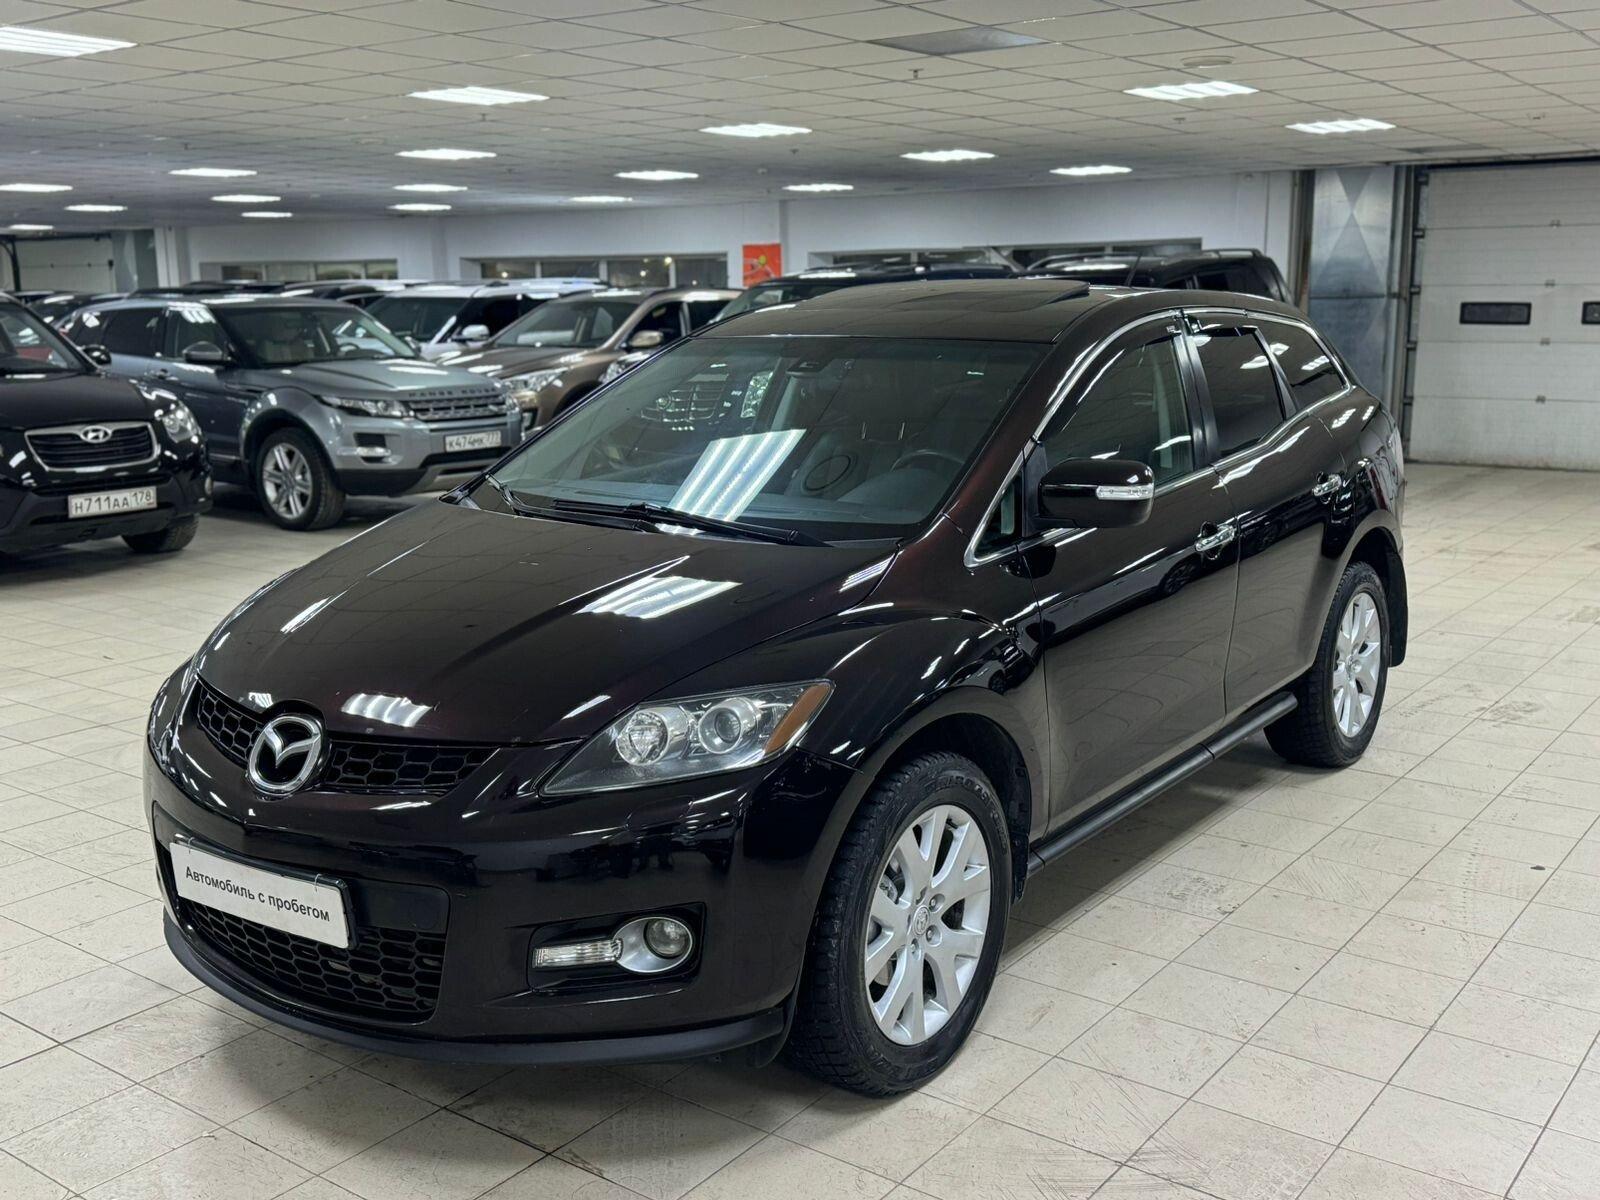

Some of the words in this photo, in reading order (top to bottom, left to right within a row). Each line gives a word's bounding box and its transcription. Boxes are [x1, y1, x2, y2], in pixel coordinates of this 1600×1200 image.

[185, 866, 255, 900] Автомобиль
[258, 891, 266, 903] с
[268, 895, 331, 922] пробегом
